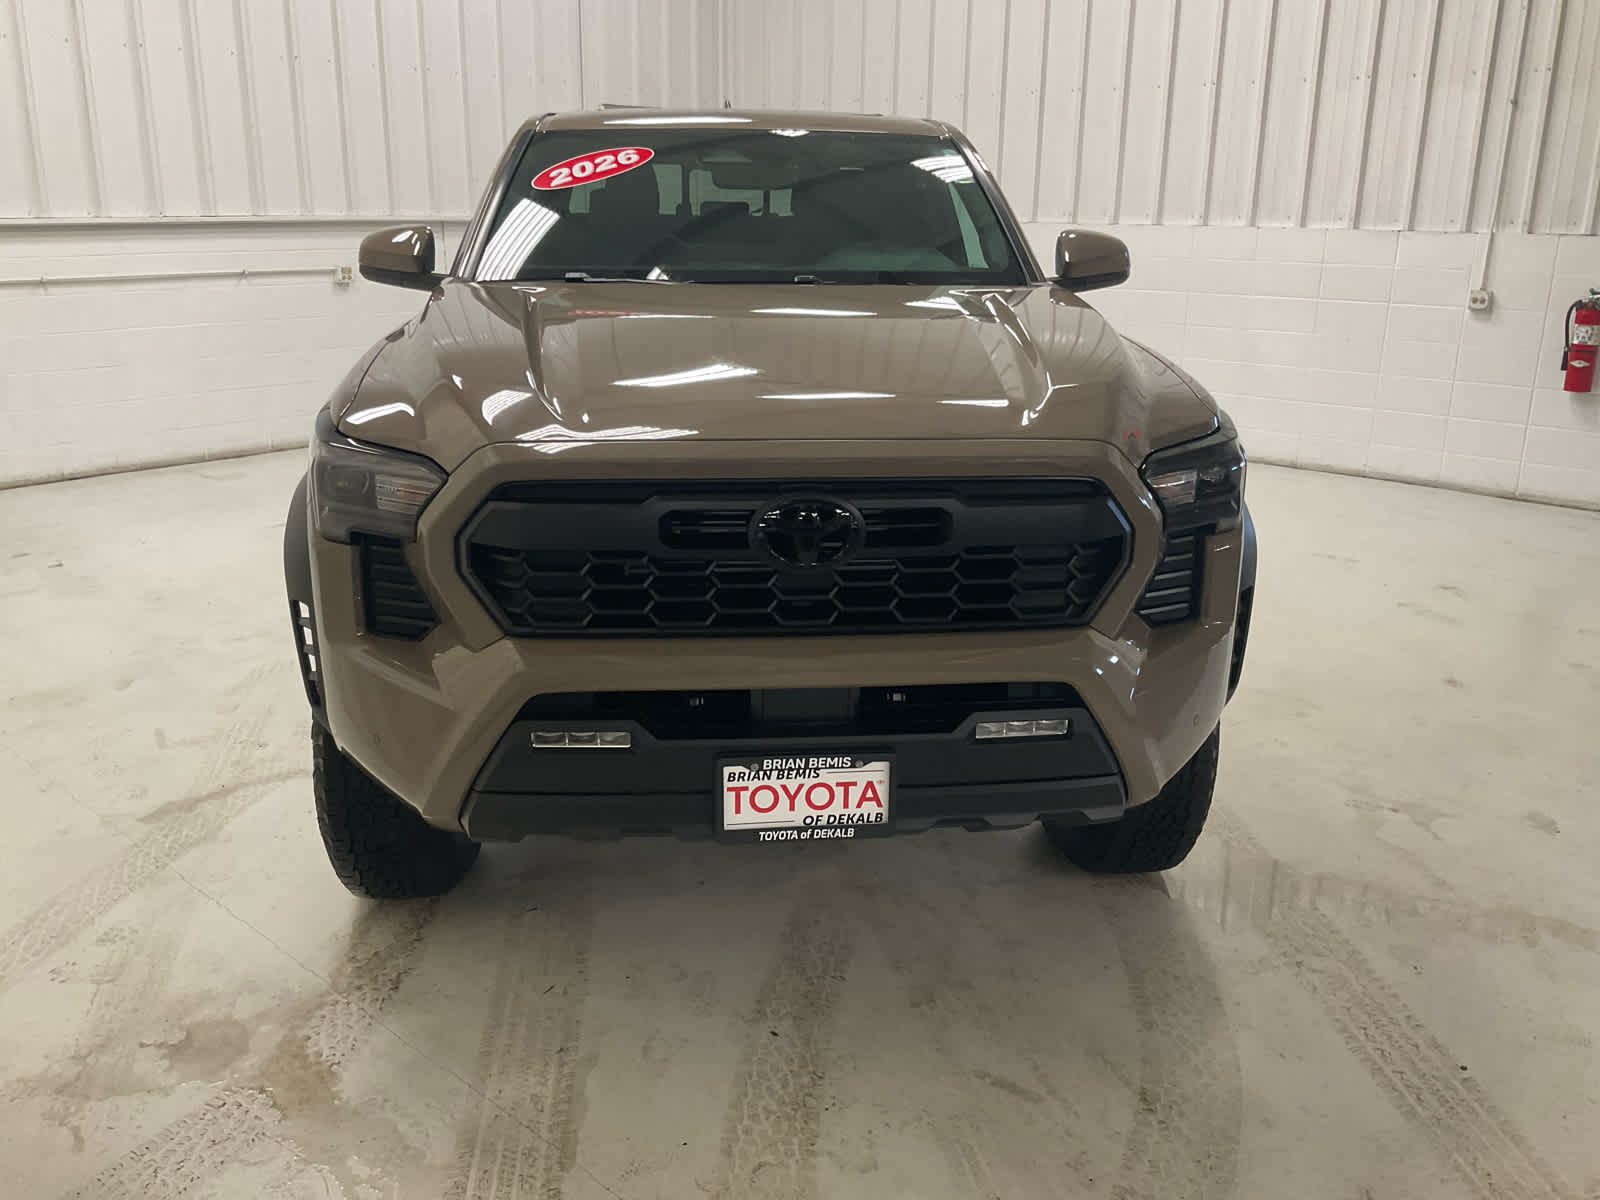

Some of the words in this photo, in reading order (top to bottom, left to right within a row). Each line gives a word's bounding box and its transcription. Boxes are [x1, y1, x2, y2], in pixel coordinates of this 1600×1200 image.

[549, 149, 640, 187] 2026
[763, 758, 806, 771] BRIAN
[808, 757, 852, 769] BEMIS
[727, 770, 773, 782] BRIAN
[776, 769, 821, 780] BEMIS
[726, 780, 883, 815] TOYOTA
[802, 815, 823, 826] OF
[826, 812, 884, 826] DEKALB
[759, 829, 798, 841] TOYOTA
[800, 828, 812, 839] of
[813, 827, 855, 840] DEKALB
